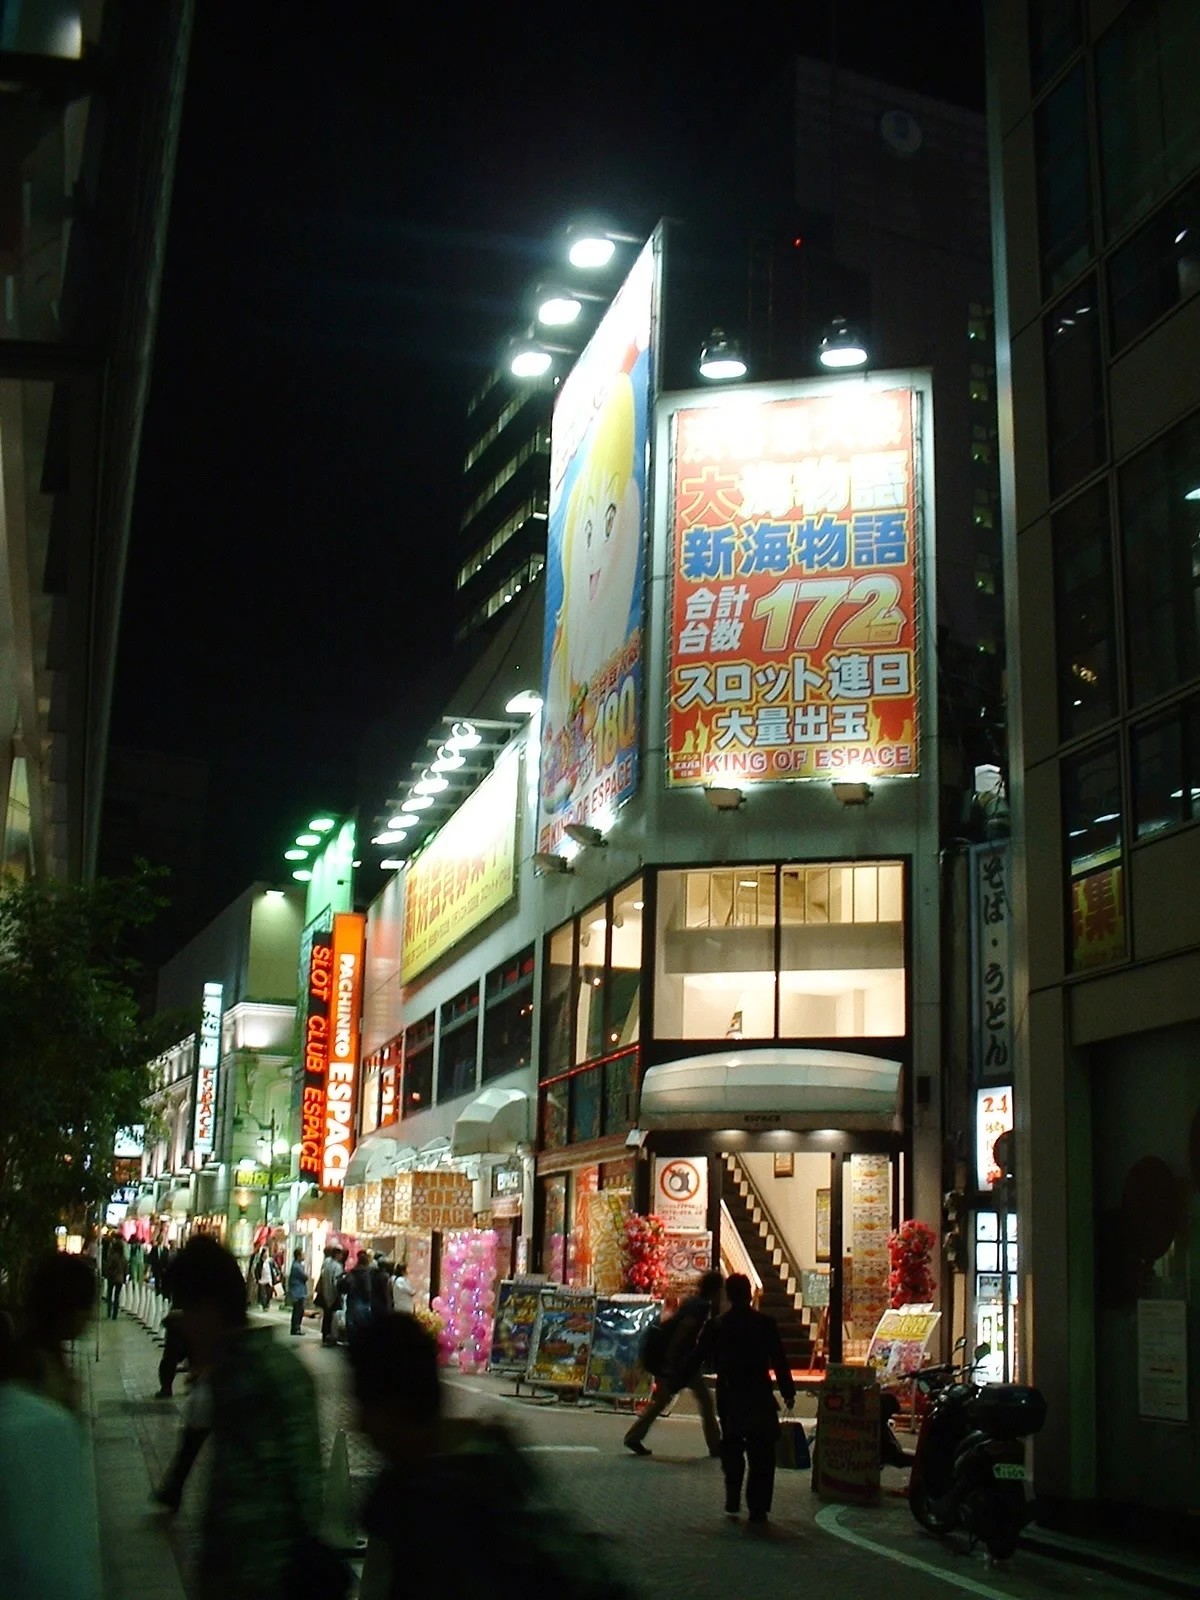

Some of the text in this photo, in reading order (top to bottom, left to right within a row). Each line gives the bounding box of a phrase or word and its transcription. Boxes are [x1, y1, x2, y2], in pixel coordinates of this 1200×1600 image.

[681, 509, 909, 580] 新海物語
[685, 583, 750, 621] 合計
[677, 618, 745, 654] 台数
[675, 650, 912, 710] スロット連日
[593, 675, 635, 777] 180
[714, 702, 871, 751] 大量出玉
[591, 757, 632, 813] ESPACE
[704, 751, 768, 773] KING
[773, 749, 808, 770] OF
[814, 745, 911, 768] ESPACE
[300, 944, 331, 1173] SLOT CLUB ESPACE
[322, 953, 356, 1189] PACHINKO ESPACE
[411, 1208, 473, 1225] ESPACE
